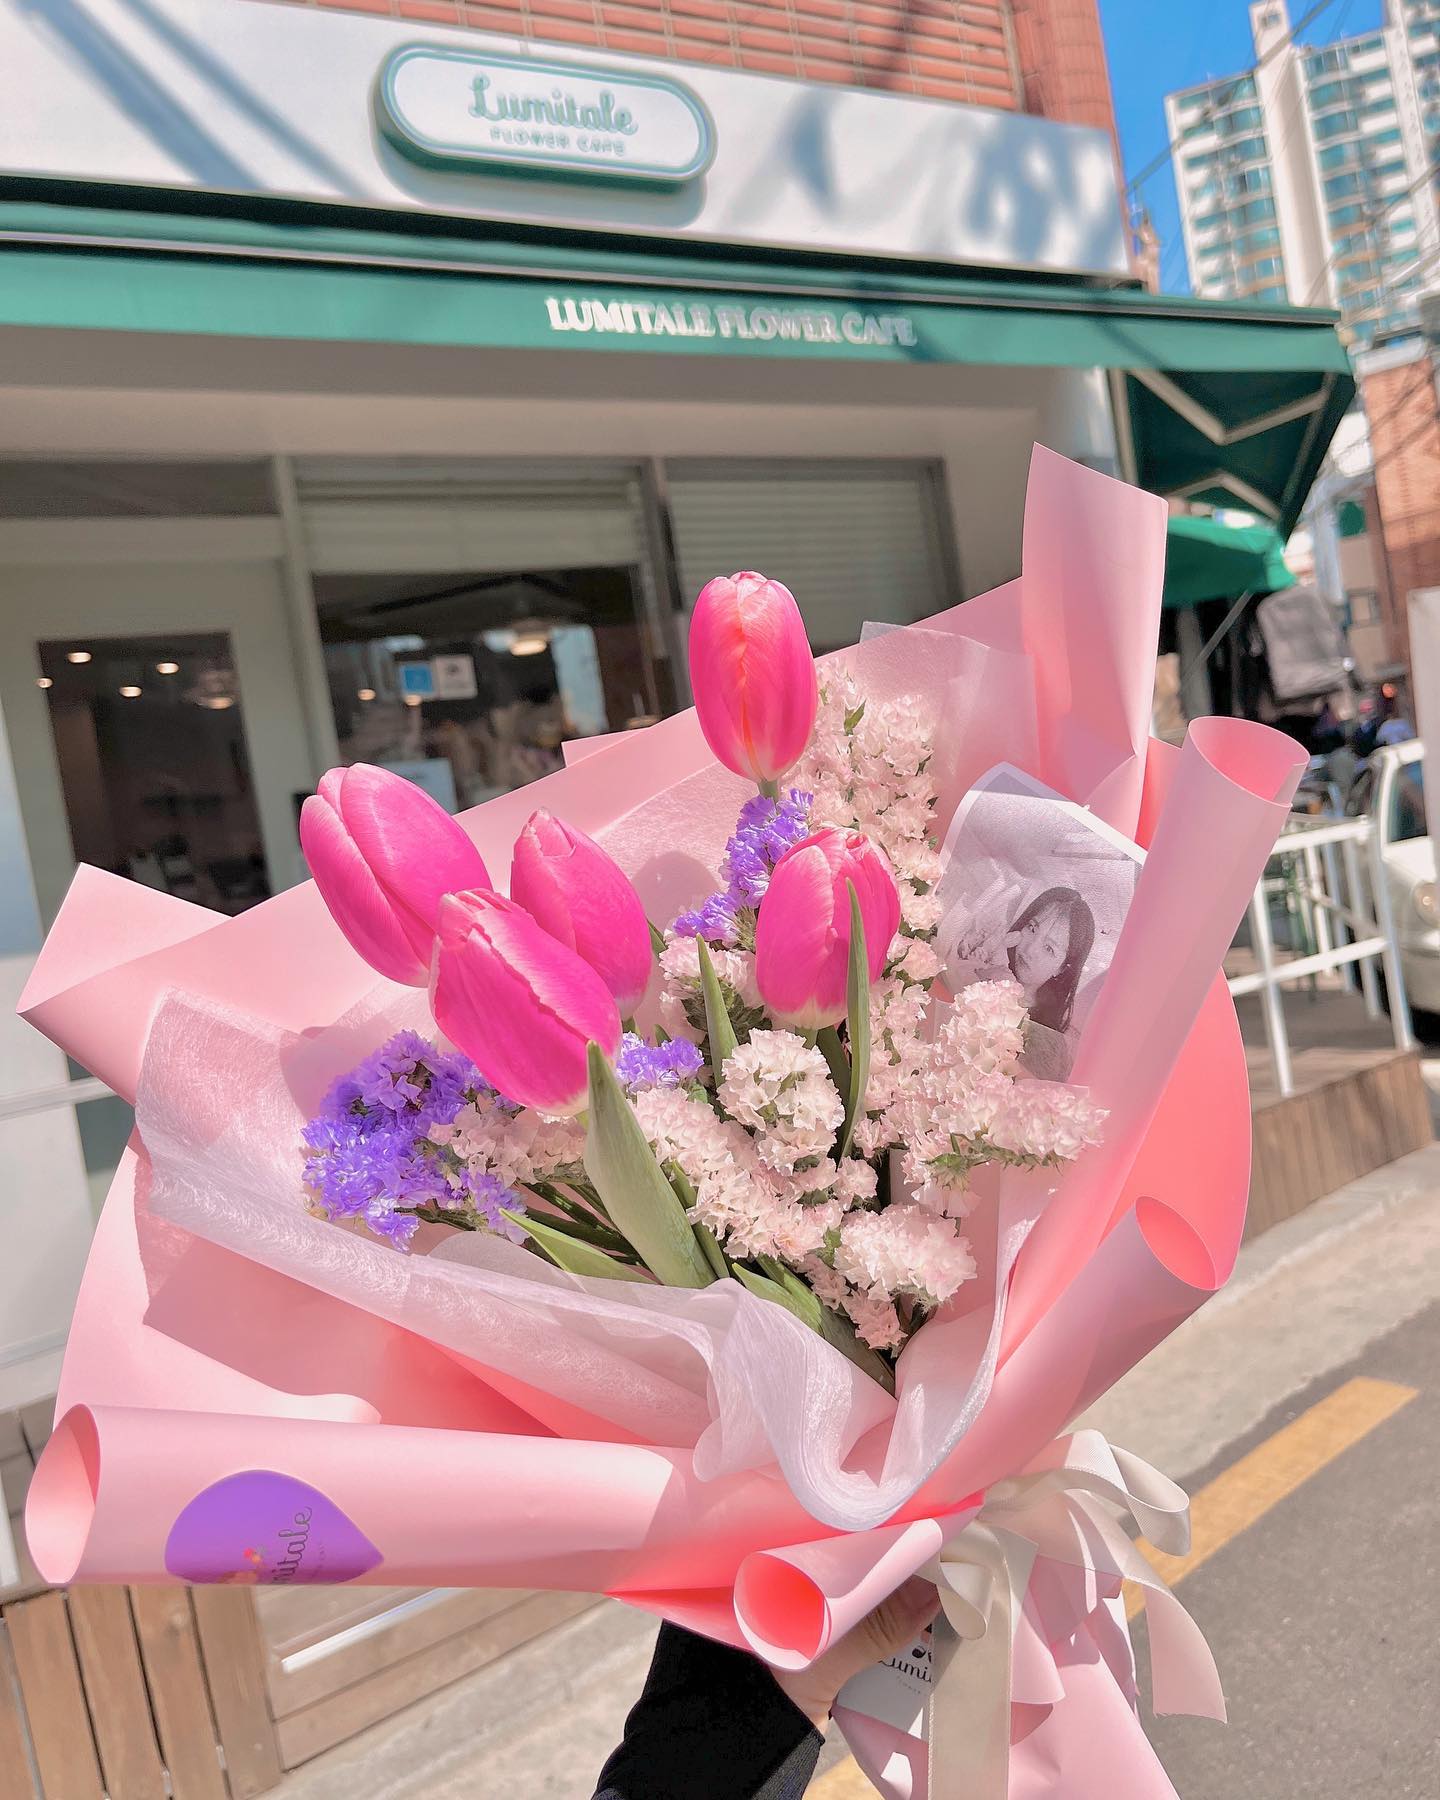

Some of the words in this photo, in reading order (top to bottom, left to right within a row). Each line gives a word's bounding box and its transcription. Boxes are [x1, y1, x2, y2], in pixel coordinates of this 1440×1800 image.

[468, 74, 639, 136] Lumitale
[490, 126, 570, 149] FLOWER
[576, 136, 625, 157] CAFE
[545, 297, 714, 337] LUMITALE
[713, 304, 842, 343] FLOWER
[841, 310, 917, 347] CAFE
